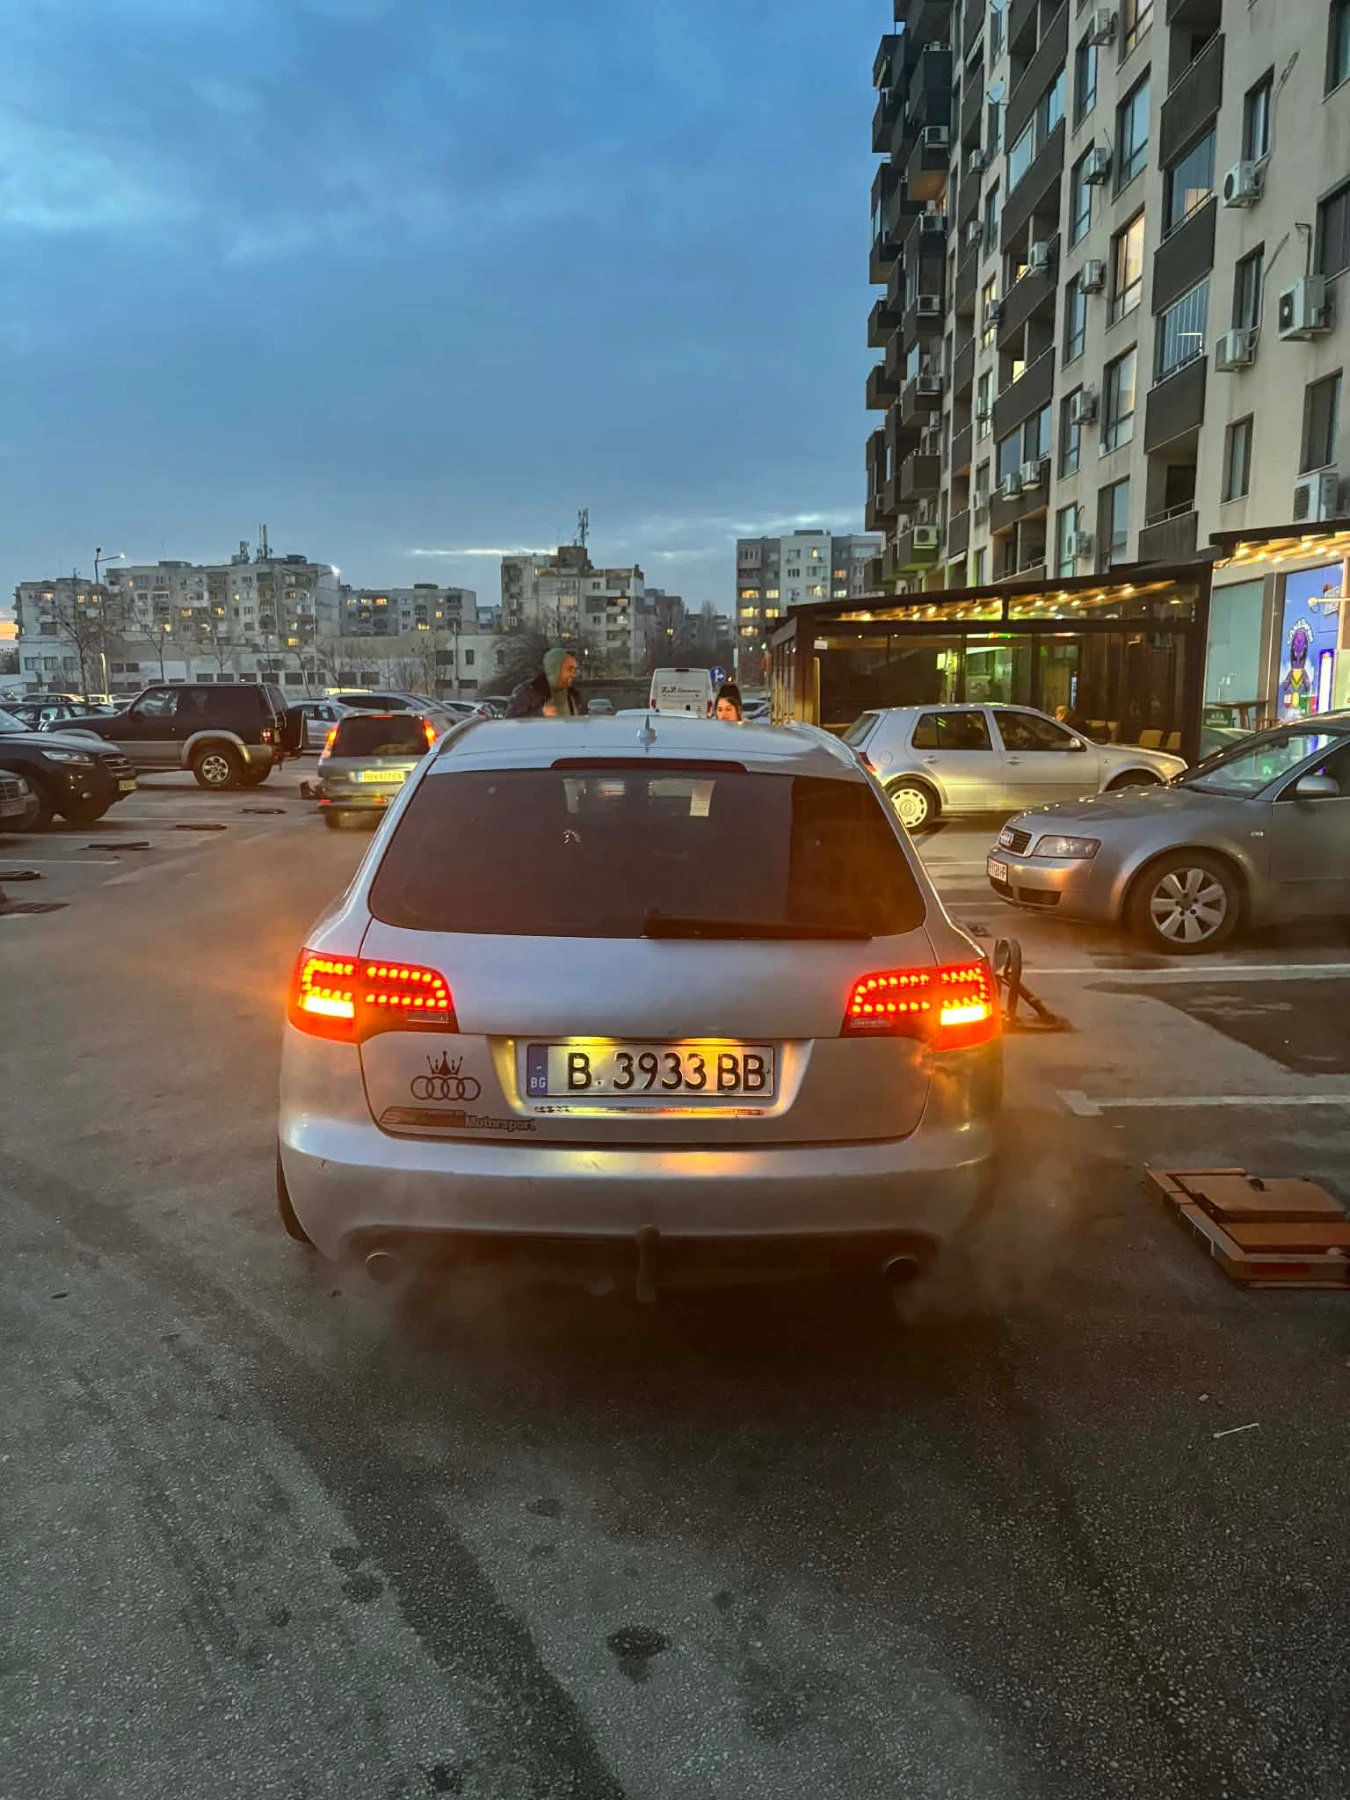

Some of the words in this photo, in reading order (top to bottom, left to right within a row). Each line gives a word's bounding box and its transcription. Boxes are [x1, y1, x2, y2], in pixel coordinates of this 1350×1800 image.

[567, 1052, 592, 1090] B
[613, 1052, 708, 1091] 3933
[717, 1053, 766, 1091] BB
[530, 1077, 546, 1088] BG
[465, 1115, 537, 1132] Motorsport
